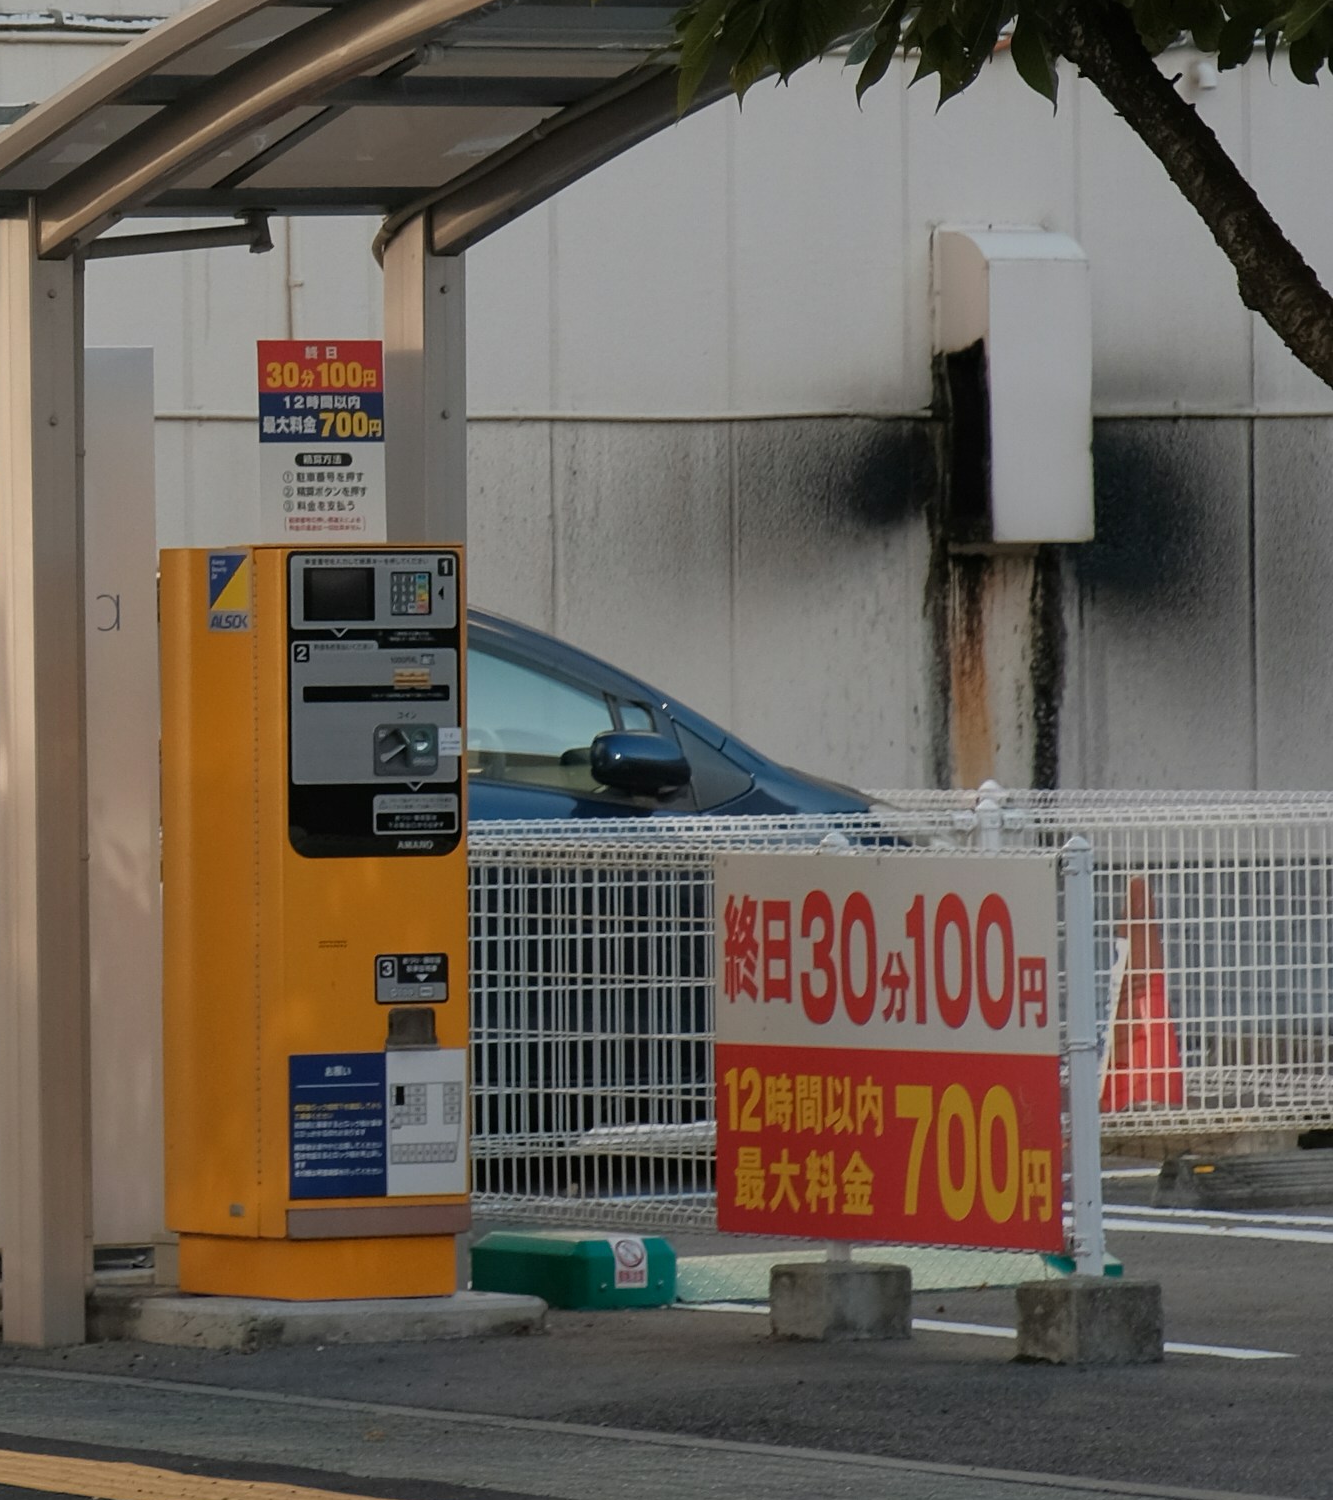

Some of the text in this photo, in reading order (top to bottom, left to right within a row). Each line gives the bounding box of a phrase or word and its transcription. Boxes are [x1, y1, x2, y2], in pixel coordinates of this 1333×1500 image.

[266, 362, 376, 388] 30分100円
[283, 396, 360, 409] 12時間以内
[441, 560, 449, 574] 1
[211, 614, 248, 629] ALSOK
[296, 646, 308, 661] 2
[382, 961, 393, 977] 3
[724, 1067, 883, 1137] 12時間以内
[895, 1083, 1052, 1223] 700円
[734, 1147, 875, 1216] 最大料金
